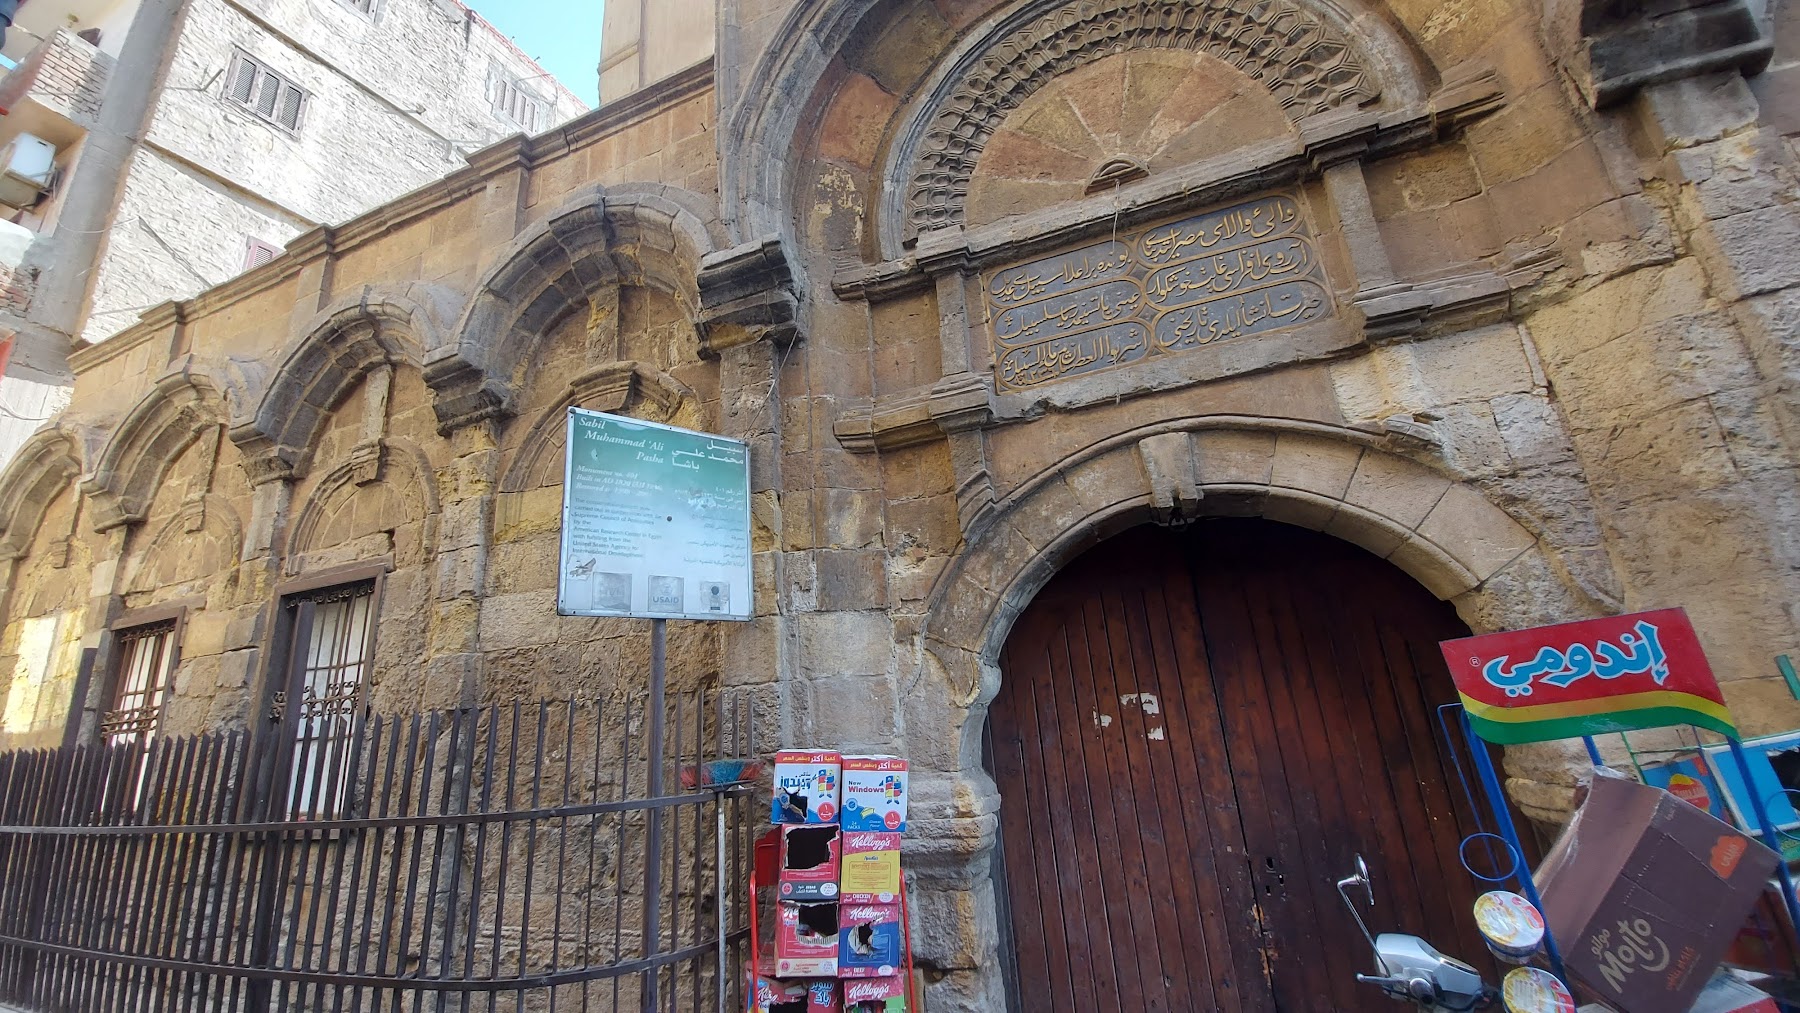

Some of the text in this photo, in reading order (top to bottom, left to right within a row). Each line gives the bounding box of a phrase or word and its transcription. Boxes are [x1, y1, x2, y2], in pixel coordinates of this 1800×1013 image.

[578, 416, 606, 430] Sabil
[584, 430, 646, 448] Muhammad
[706, 440, 744, 455] سبيل
[636, 451, 664, 464] Pasha
[672, 448, 744, 465] محمد علي
[672, 456, 700, 472] باشا
[576, 464, 613, 476] Monument
[576, 474, 594, 482] Built
[652, 595, 680, 604] USAID
[1482, 620, 1670, 698] إندومي
[820, 810, 832, 818] جنيه
[852, 834, 890, 850] Kellogg's
[1599, 918, 1652, 994] Molto
[810, 982, 834, 992] سوبر
[849, 982, 890, 998] Kellogg's
